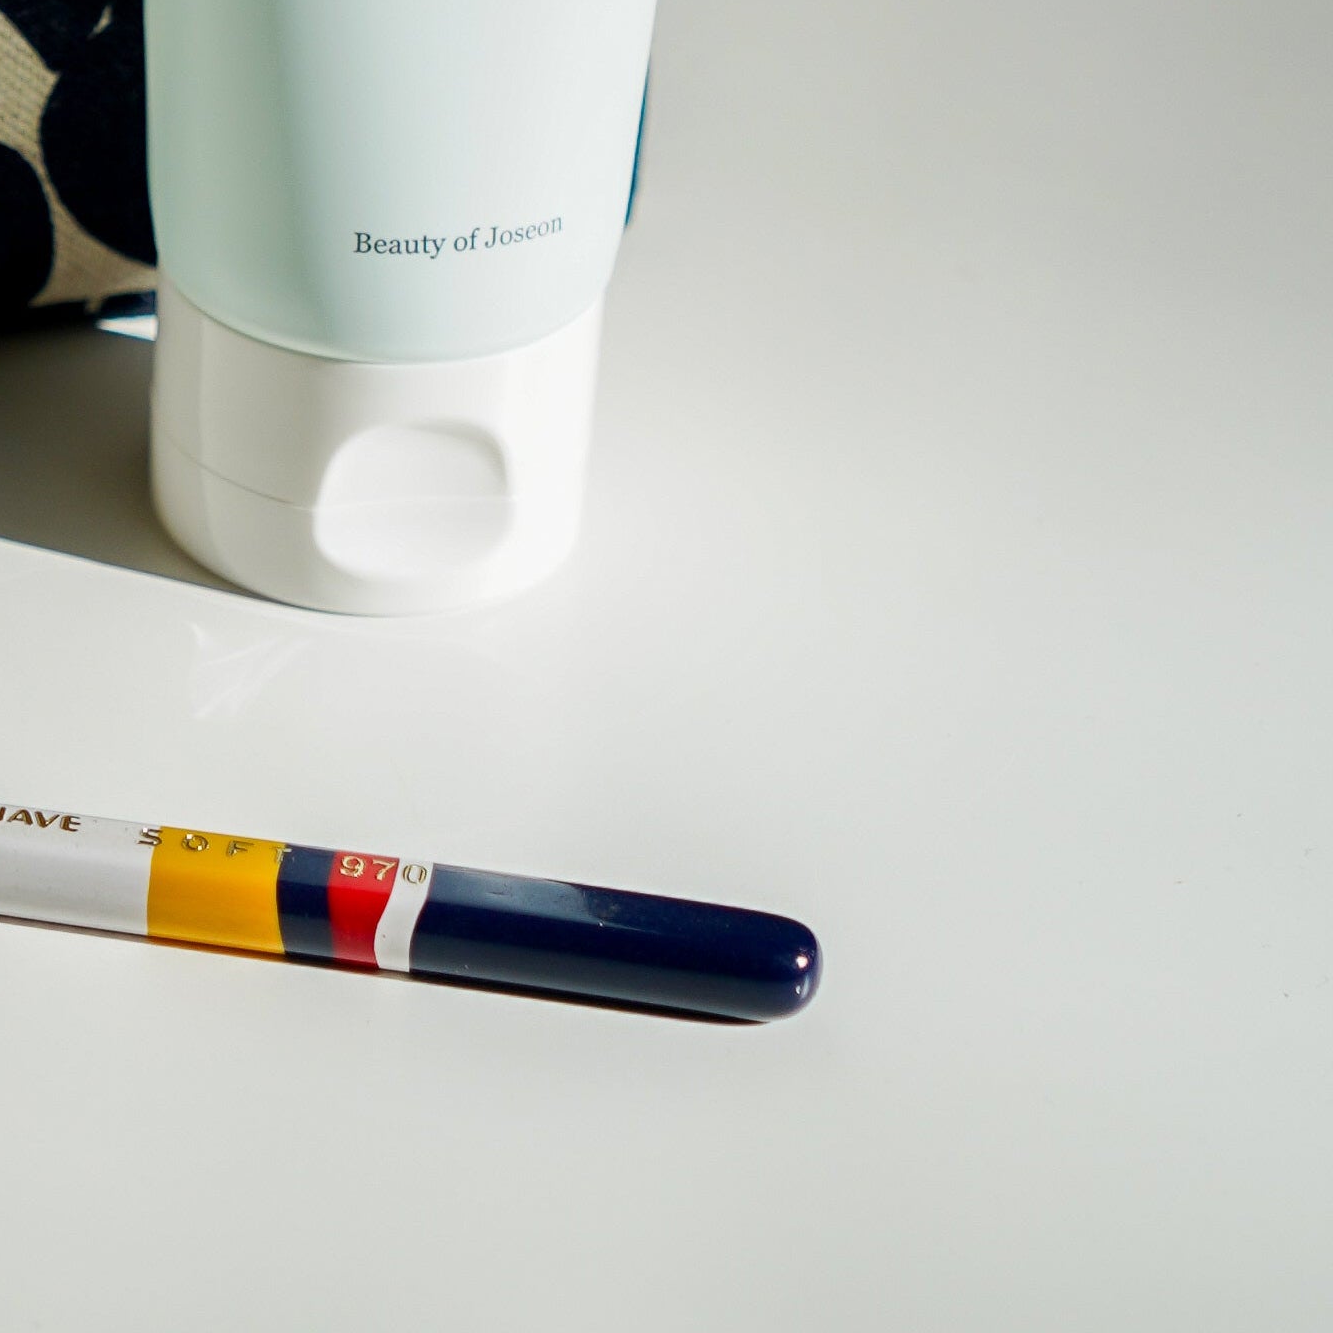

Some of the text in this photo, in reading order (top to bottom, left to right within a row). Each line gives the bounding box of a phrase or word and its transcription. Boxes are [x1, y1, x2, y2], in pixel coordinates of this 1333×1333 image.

[353, 215, 563, 260] Beauty of Joseon
[137, 827, 292, 864] SOFT
[339, 855, 428, 884] 970
